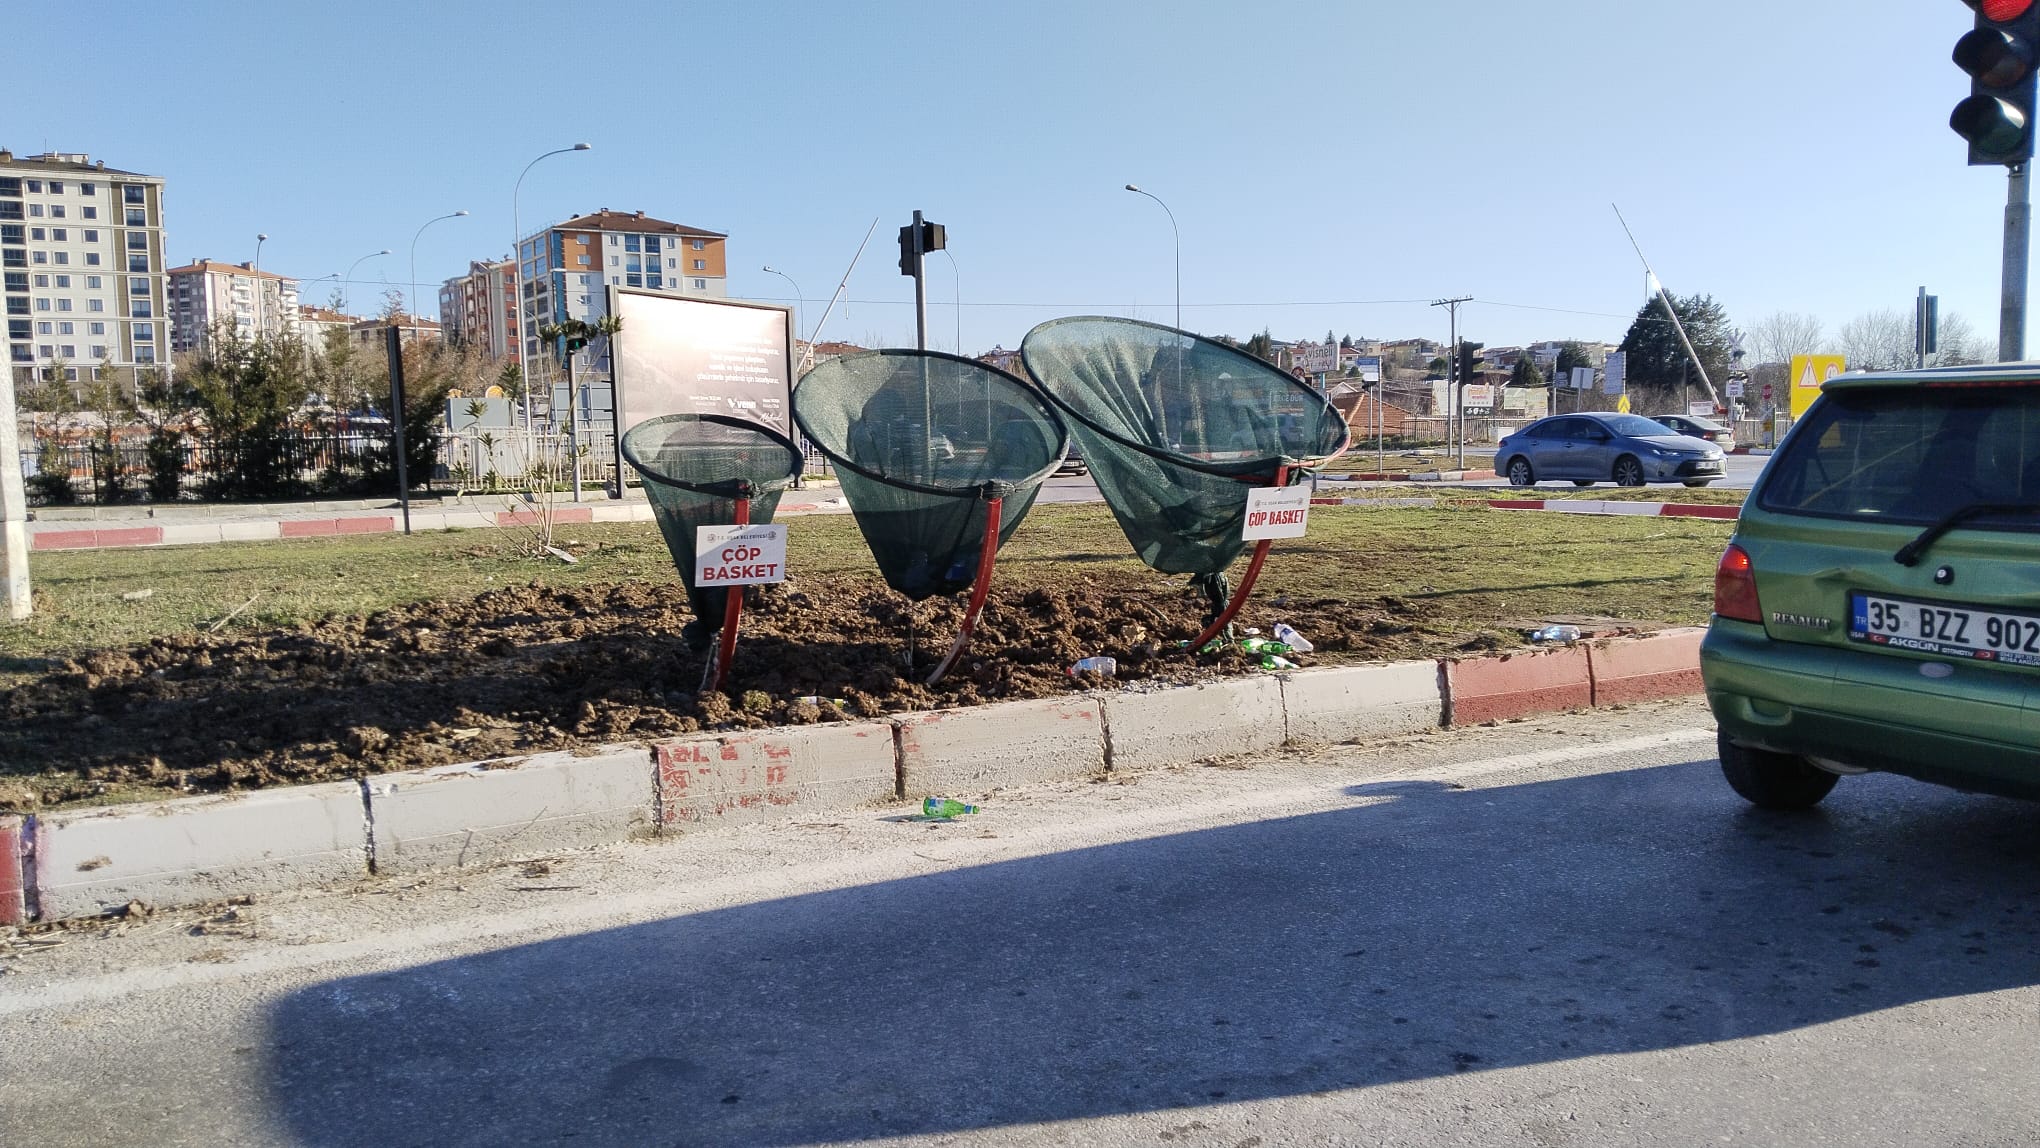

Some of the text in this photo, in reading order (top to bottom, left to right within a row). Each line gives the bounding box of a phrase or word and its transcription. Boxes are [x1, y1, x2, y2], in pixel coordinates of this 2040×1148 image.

[1269, 510, 1304, 525] BASKET
[722, 545, 760, 564] ÇÖP
[703, 564, 777, 580] BASKET
[1772, 612, 1831, 629] RENAULT
[1856, 615, 1867, 625] TR
[1870, 601, 2040, 653] 35 BZZ 902
[1888, 637, 1939, 652] AKGÜN
